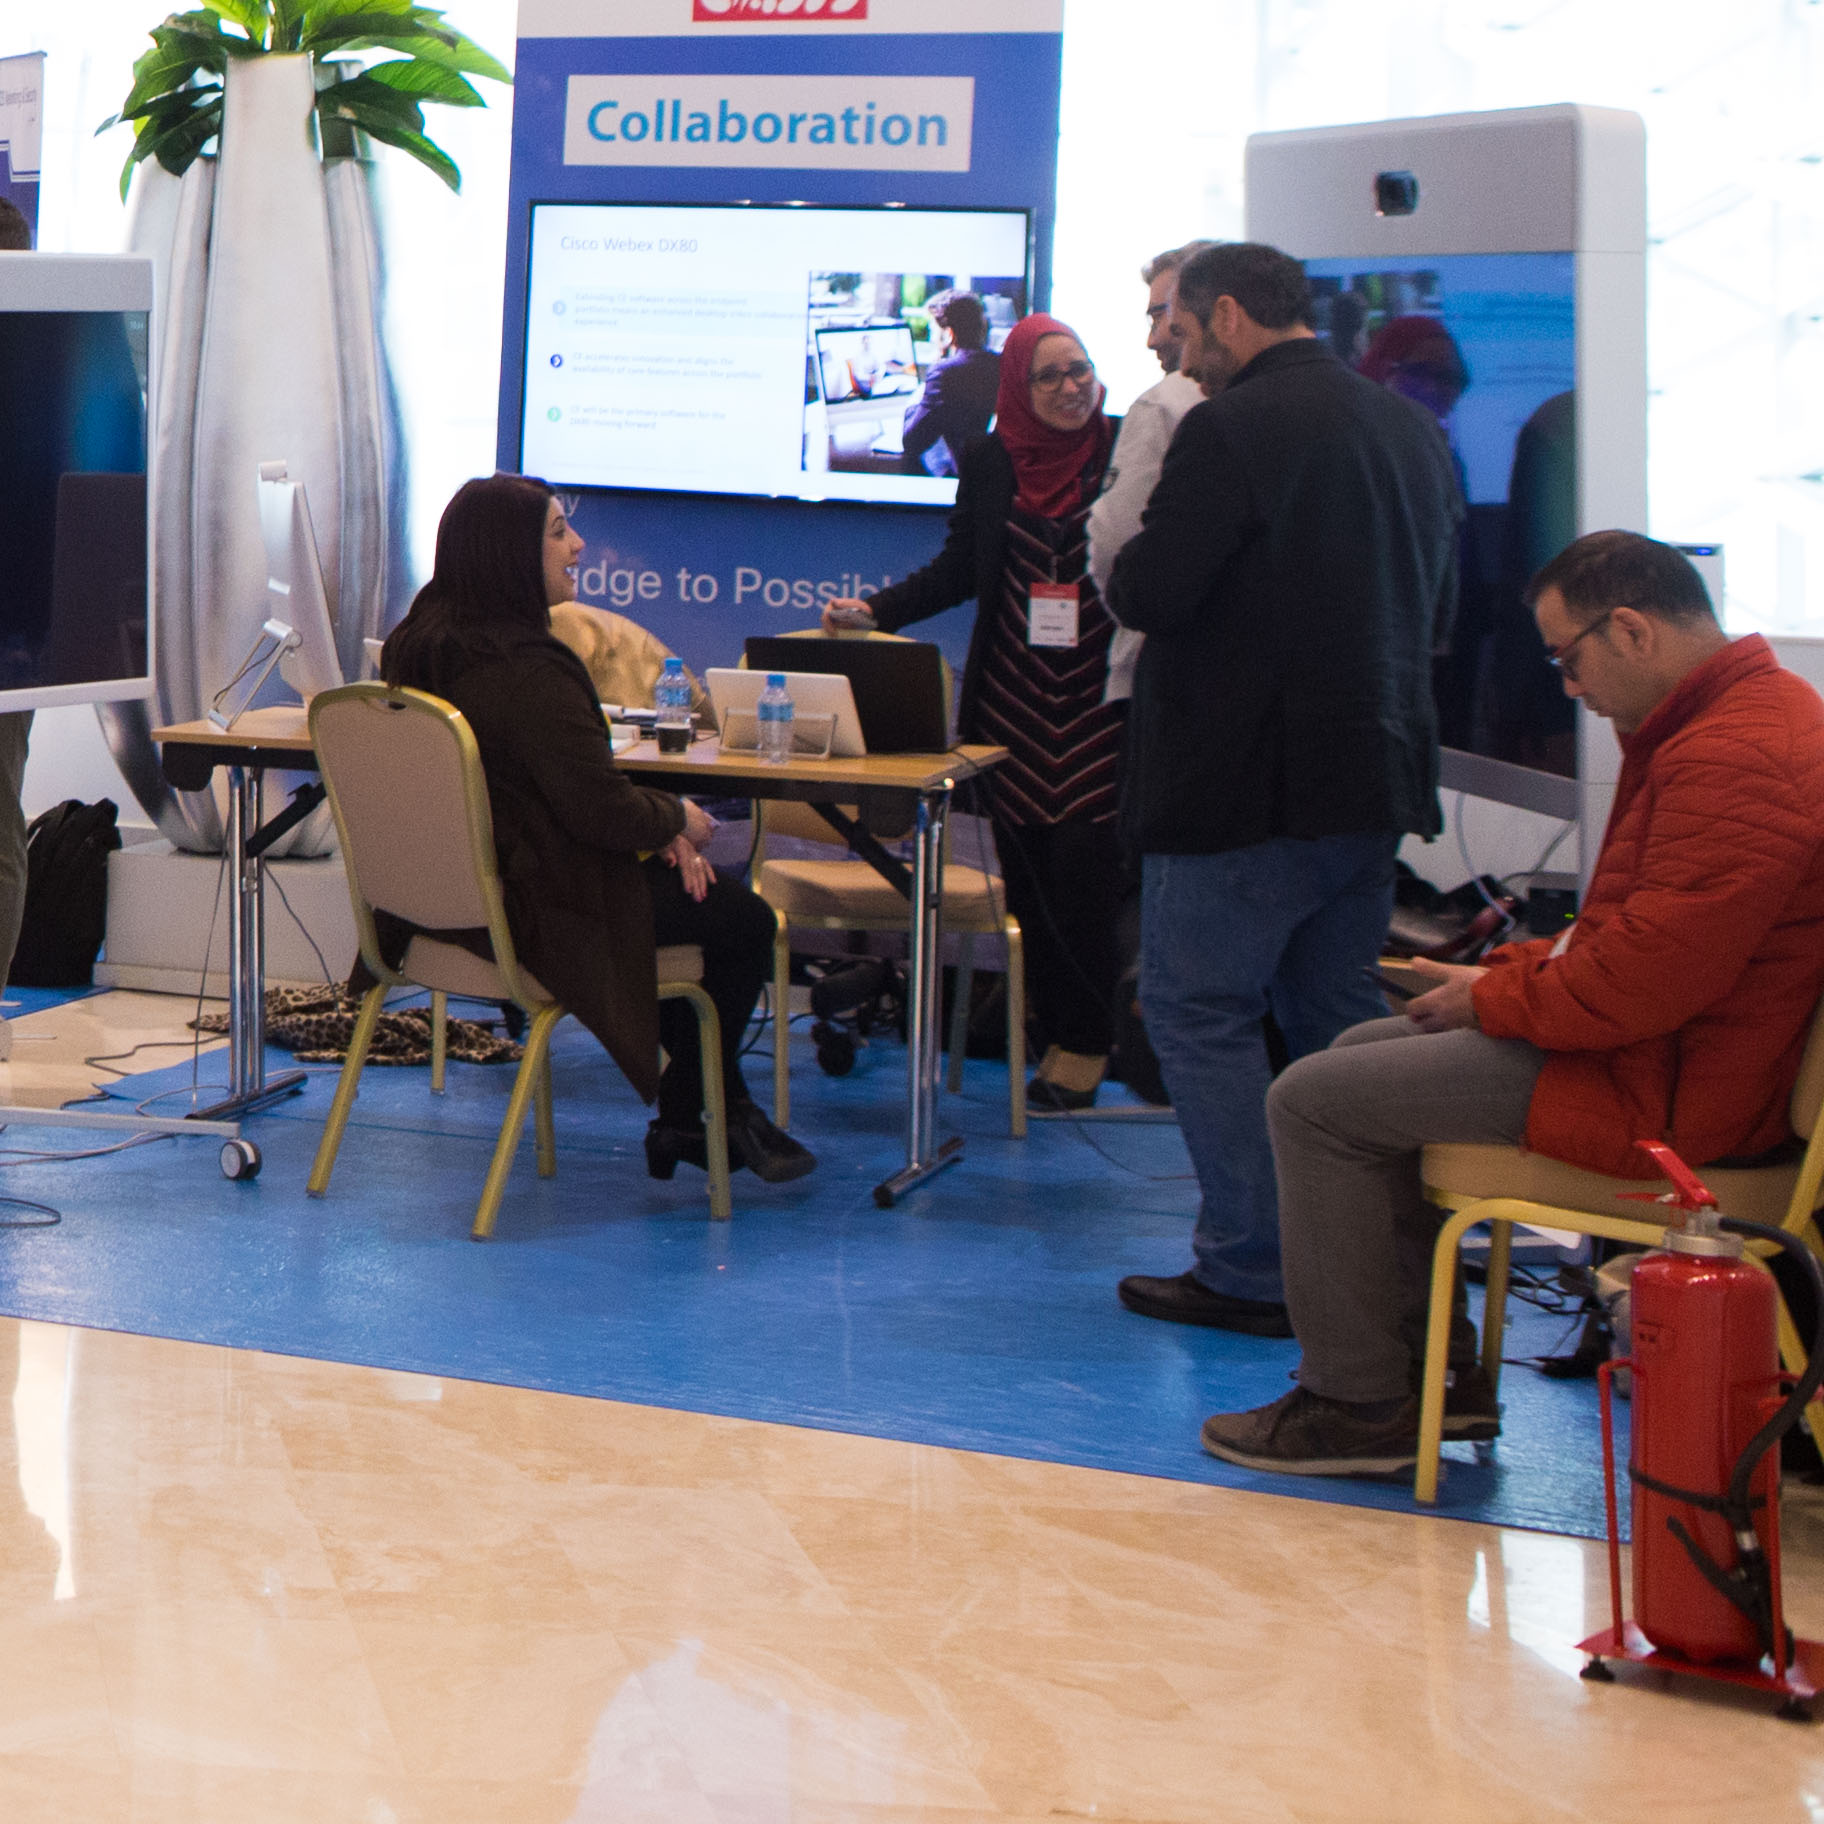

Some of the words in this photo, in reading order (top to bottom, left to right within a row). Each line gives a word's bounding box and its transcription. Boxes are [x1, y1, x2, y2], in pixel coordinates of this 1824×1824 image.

[587, 98, 949, 147] Collaboration
[560, 235, 598, 251] Cisco
[603, 236, 653, 253] Webex
[658, 238, 699, 254] DX80
[676, 567, 719, 603] to
